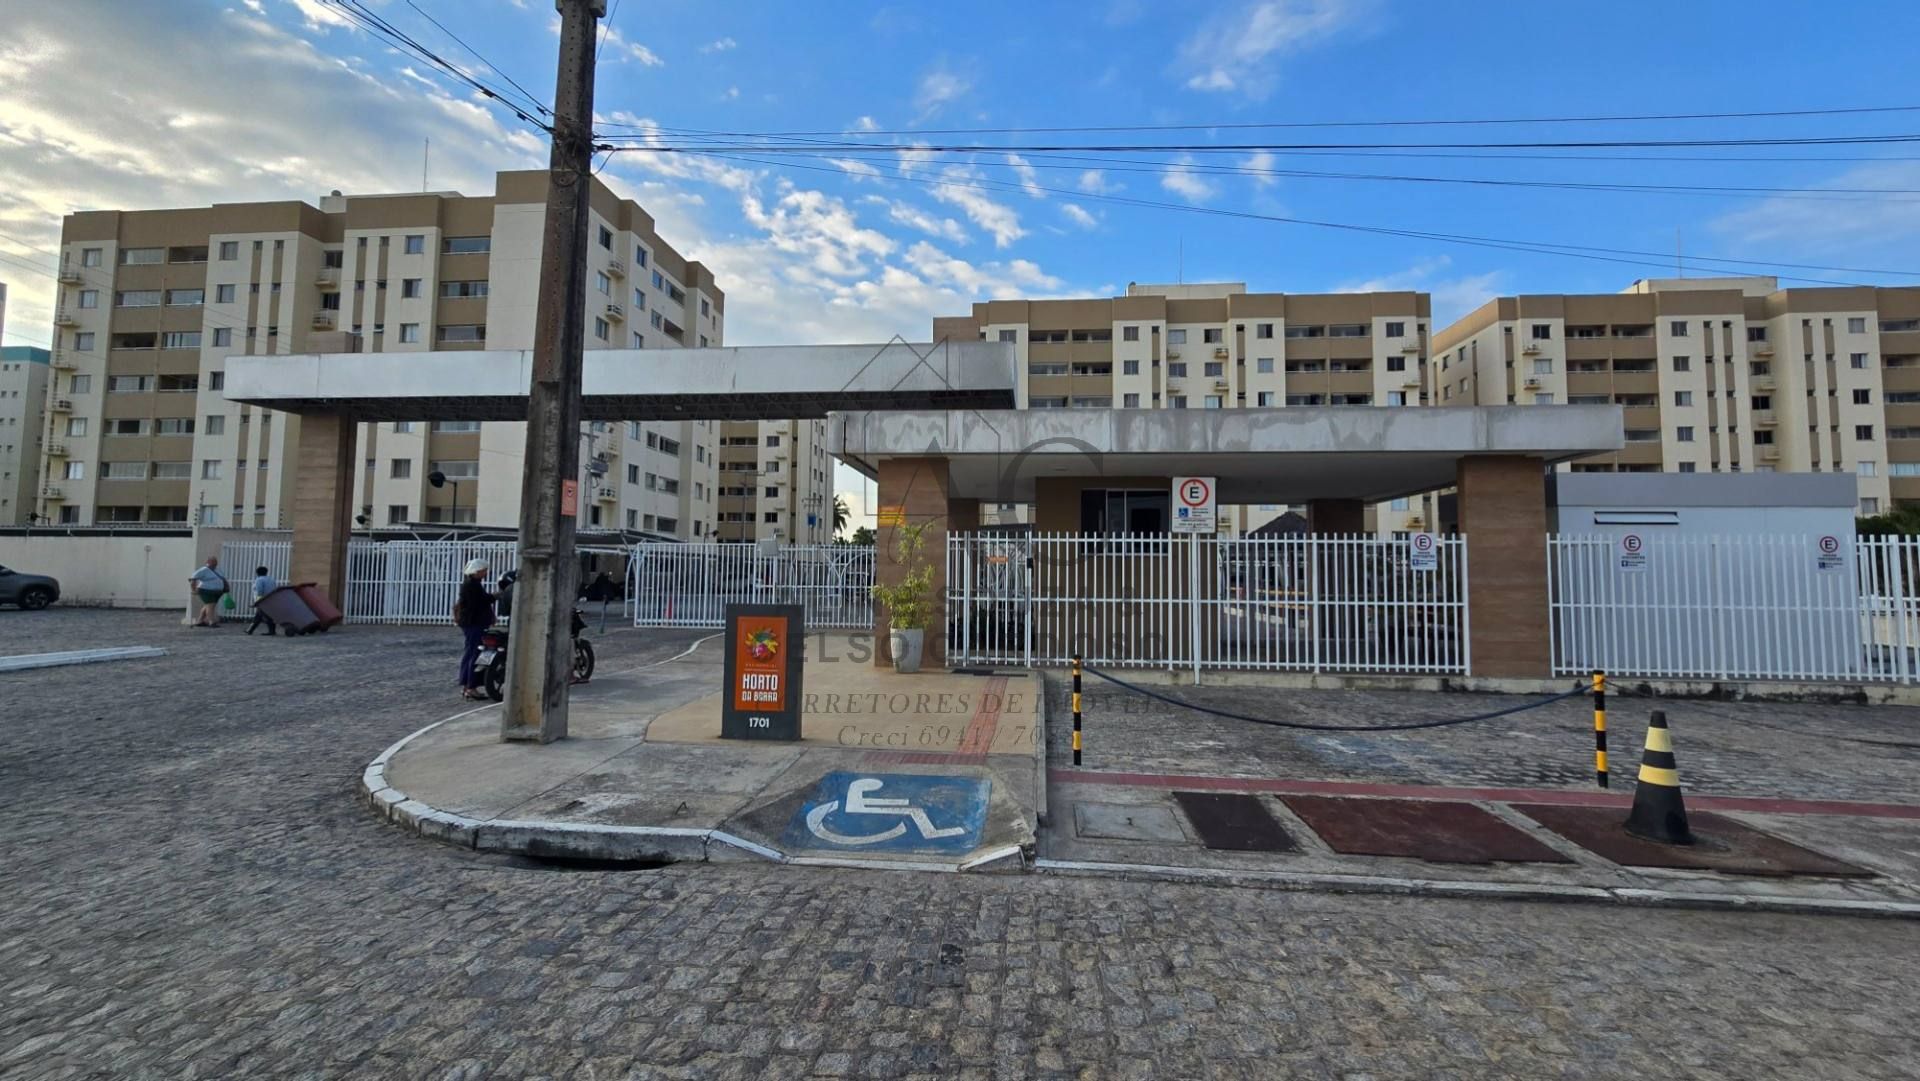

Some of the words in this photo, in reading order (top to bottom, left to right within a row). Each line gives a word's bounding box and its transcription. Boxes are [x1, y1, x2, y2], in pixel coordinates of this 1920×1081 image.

[1189, 486, 1200, 499] E
[1419, 537, 1427, 548] E
[1628, 538, 1637, 549] E
[1824, 539, 1833, 550] E
[742, 673, 778, 691] HORTO
[749, 717, 770, 728] 1701
